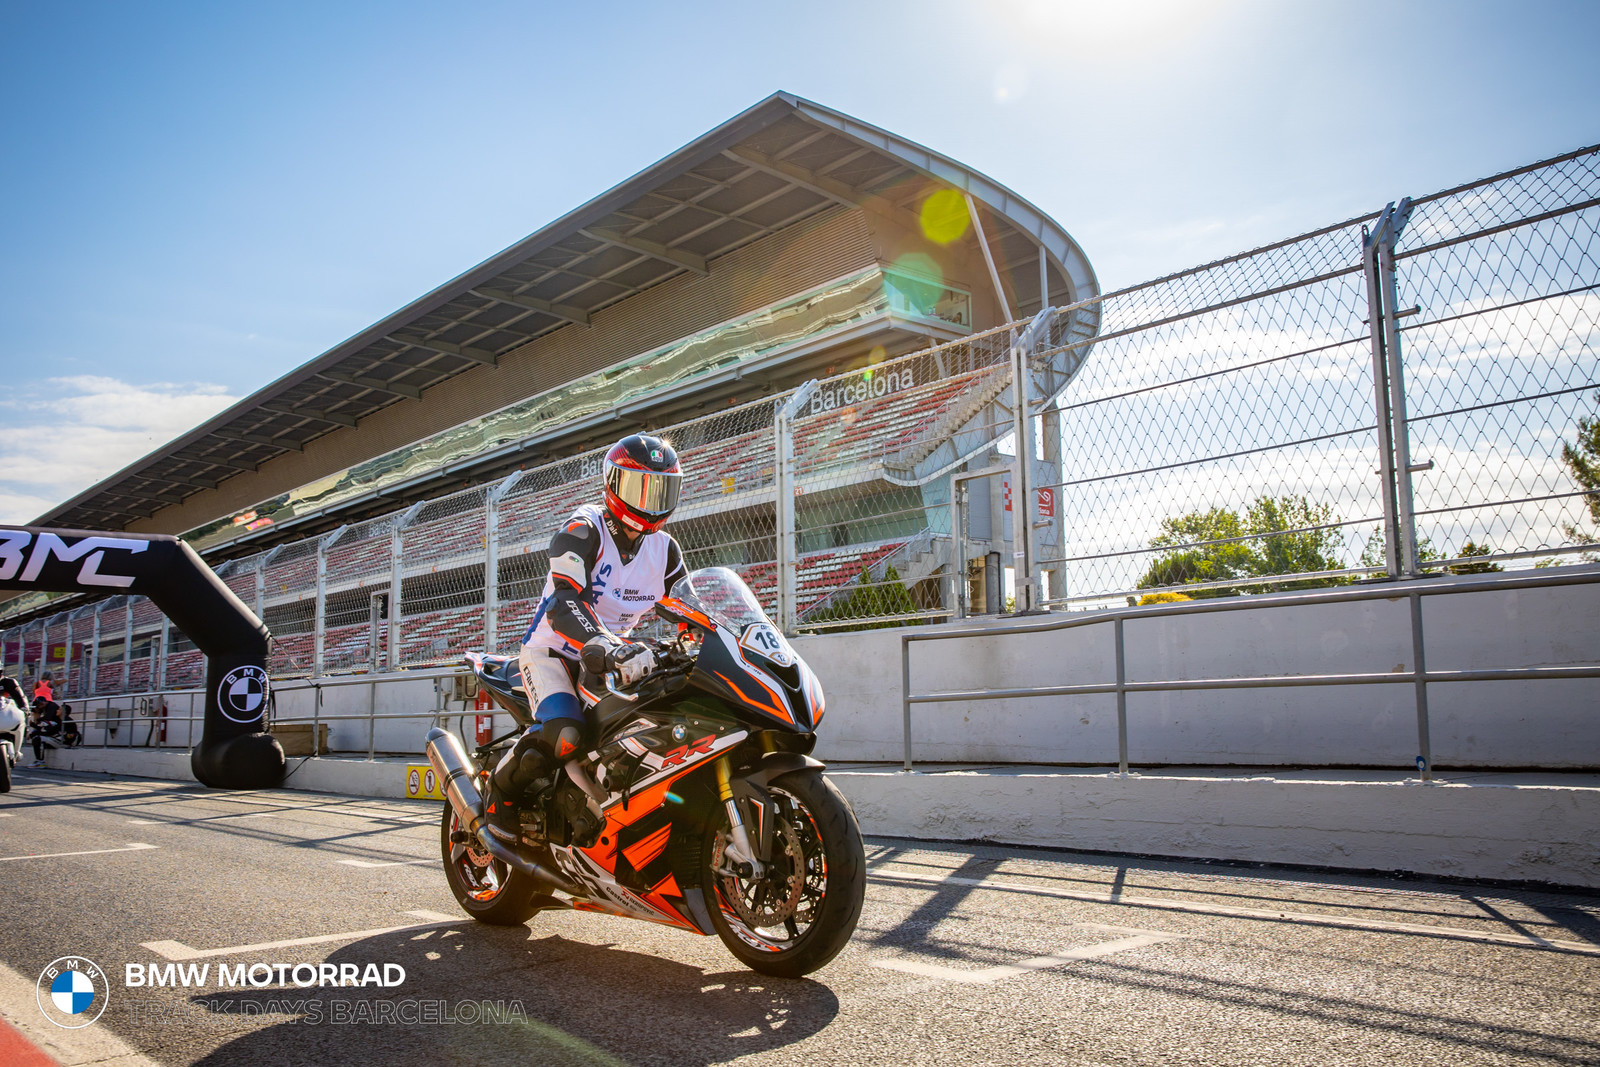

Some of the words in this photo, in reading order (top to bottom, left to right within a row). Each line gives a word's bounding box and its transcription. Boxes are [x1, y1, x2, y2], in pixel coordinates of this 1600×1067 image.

[810, 368, 914, 414] Barcelona
[592, 562, 612, 605] AYS
[754, 631, 781, 650] 18
[661, 733, 716, 769] RR
[606, 886, 629, 906] Castrol
